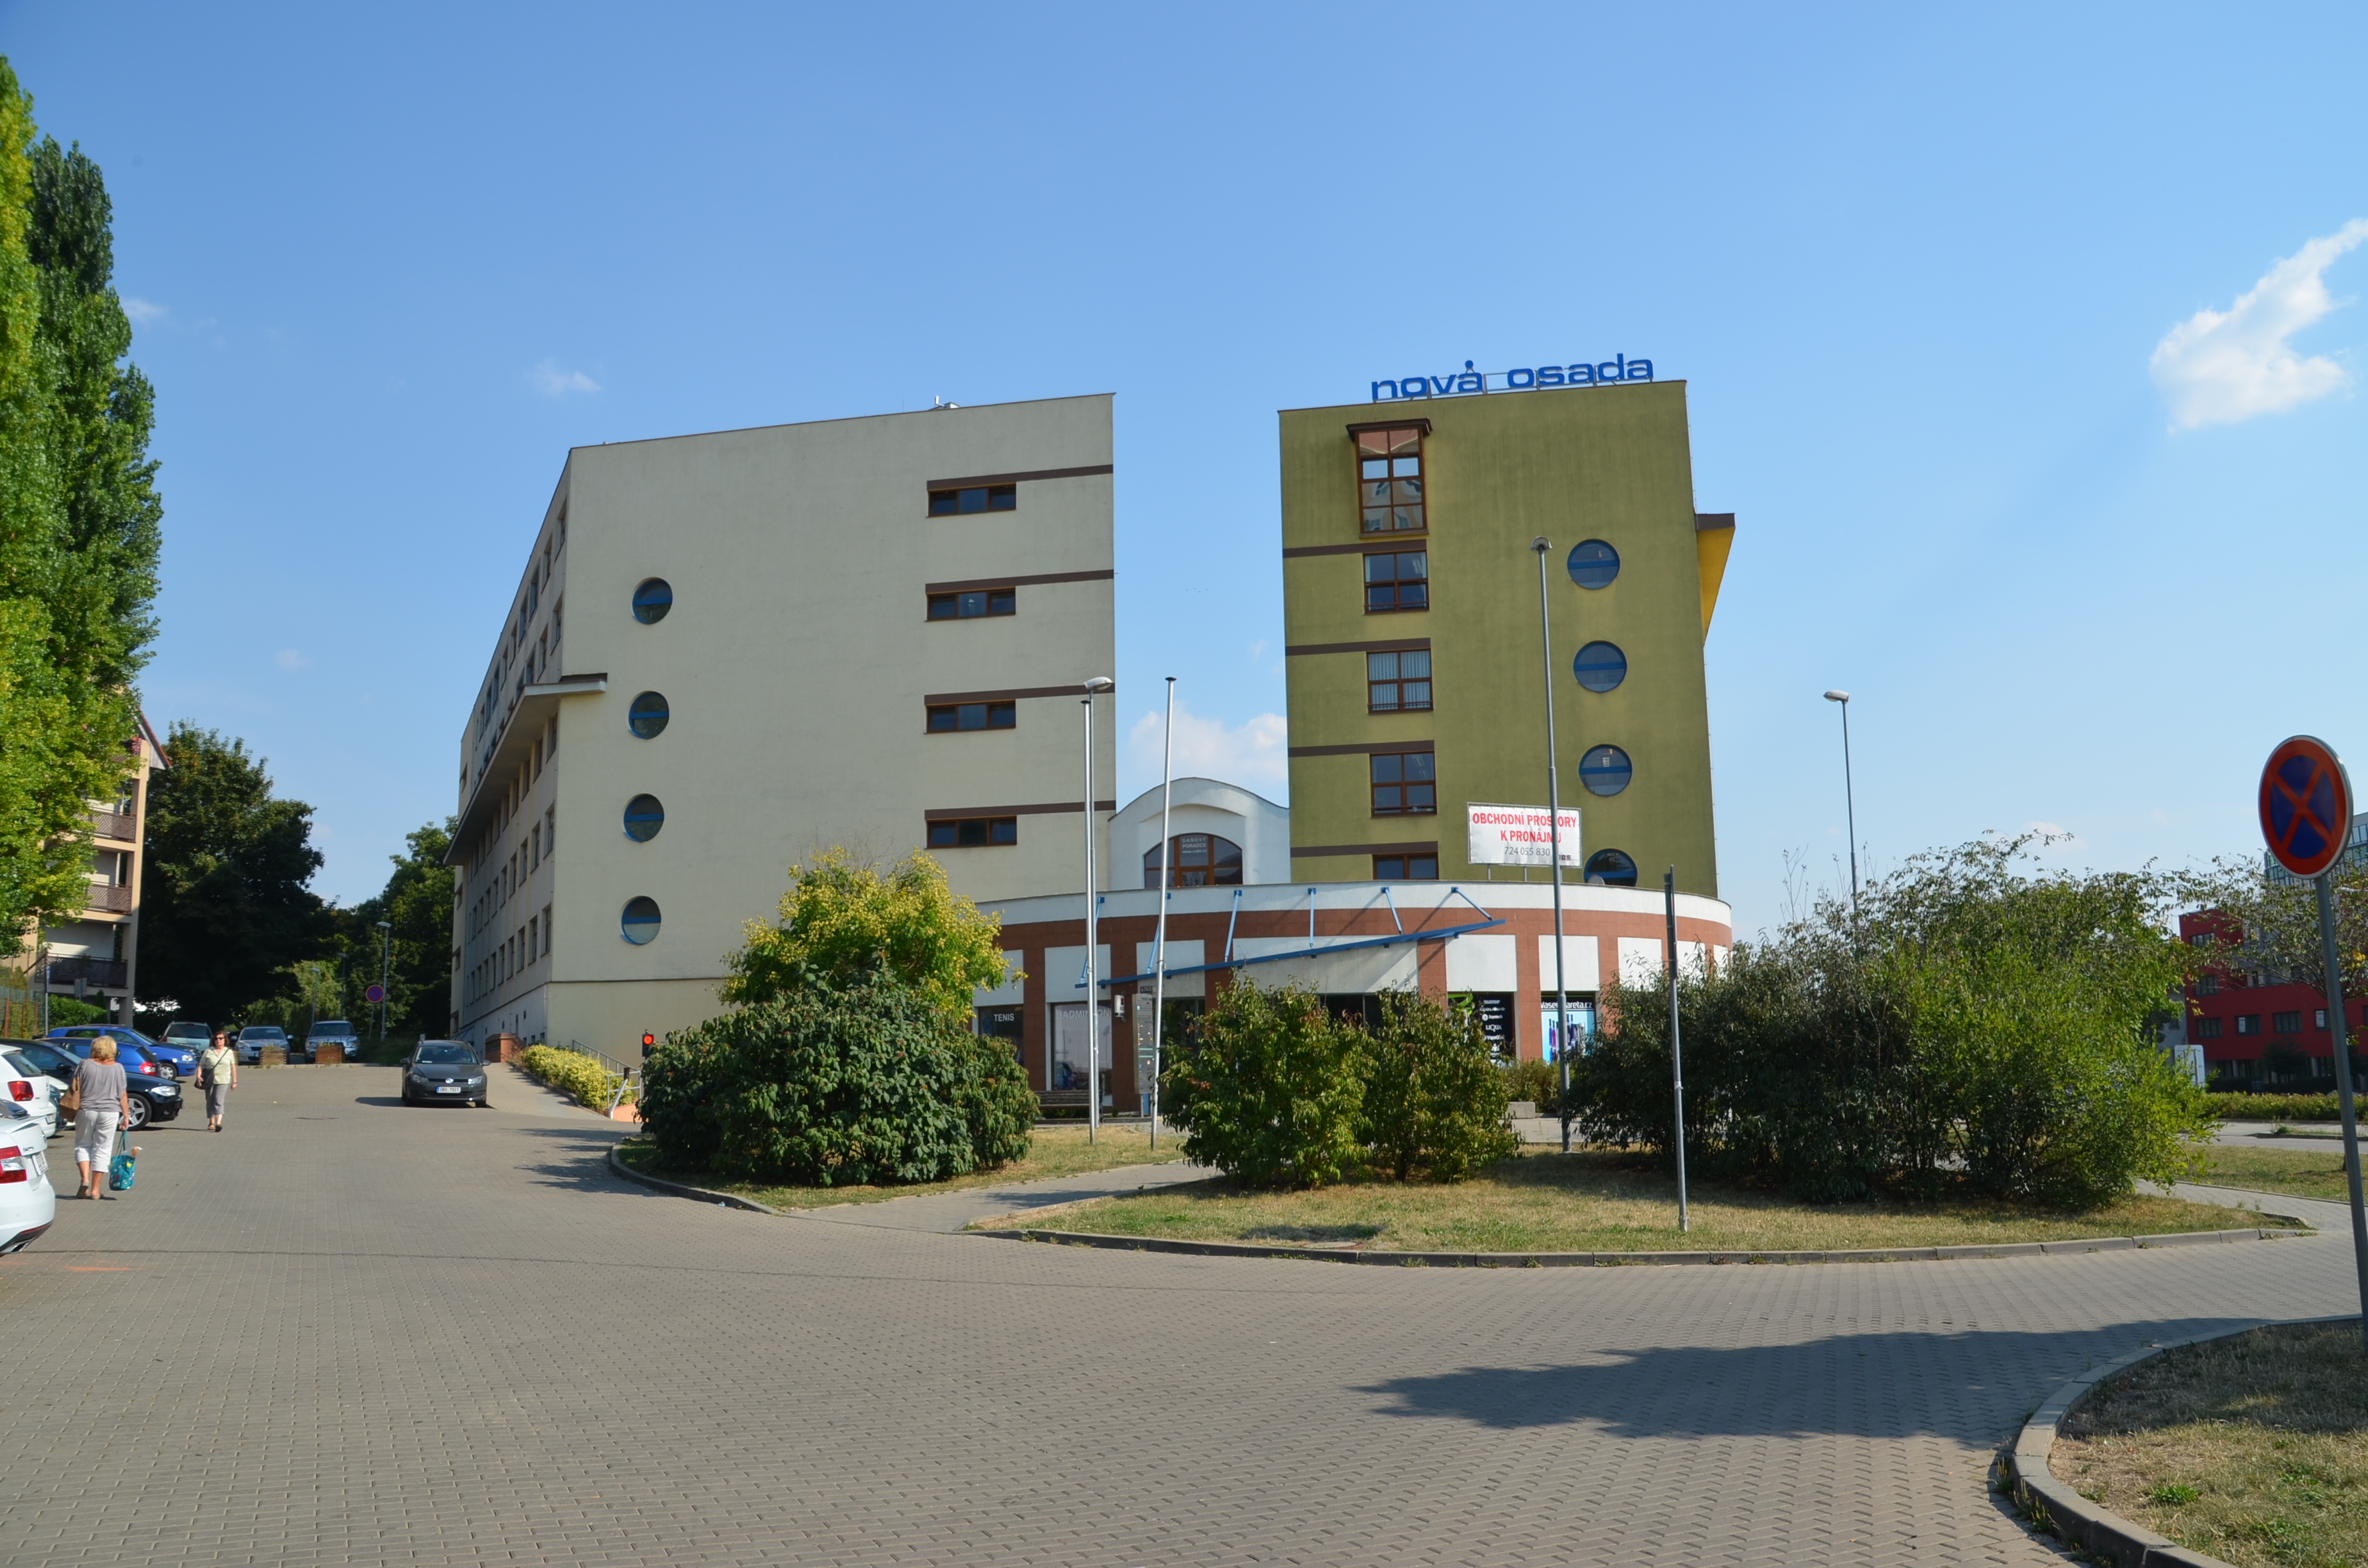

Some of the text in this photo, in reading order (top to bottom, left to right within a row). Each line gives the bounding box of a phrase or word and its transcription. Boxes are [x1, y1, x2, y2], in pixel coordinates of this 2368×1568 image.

[1508, 353, 1654, 388] osada
[1472, 811, 1577, 828] OBCHODNÍ PROSORY
[1501, 830, 1508, 841] K
[1504, 847, 1550, 856] 724 055 830
[994, 1013, 1014, 1022] TENIS
[1057, 1009, 1110, 1018] BADMINON
